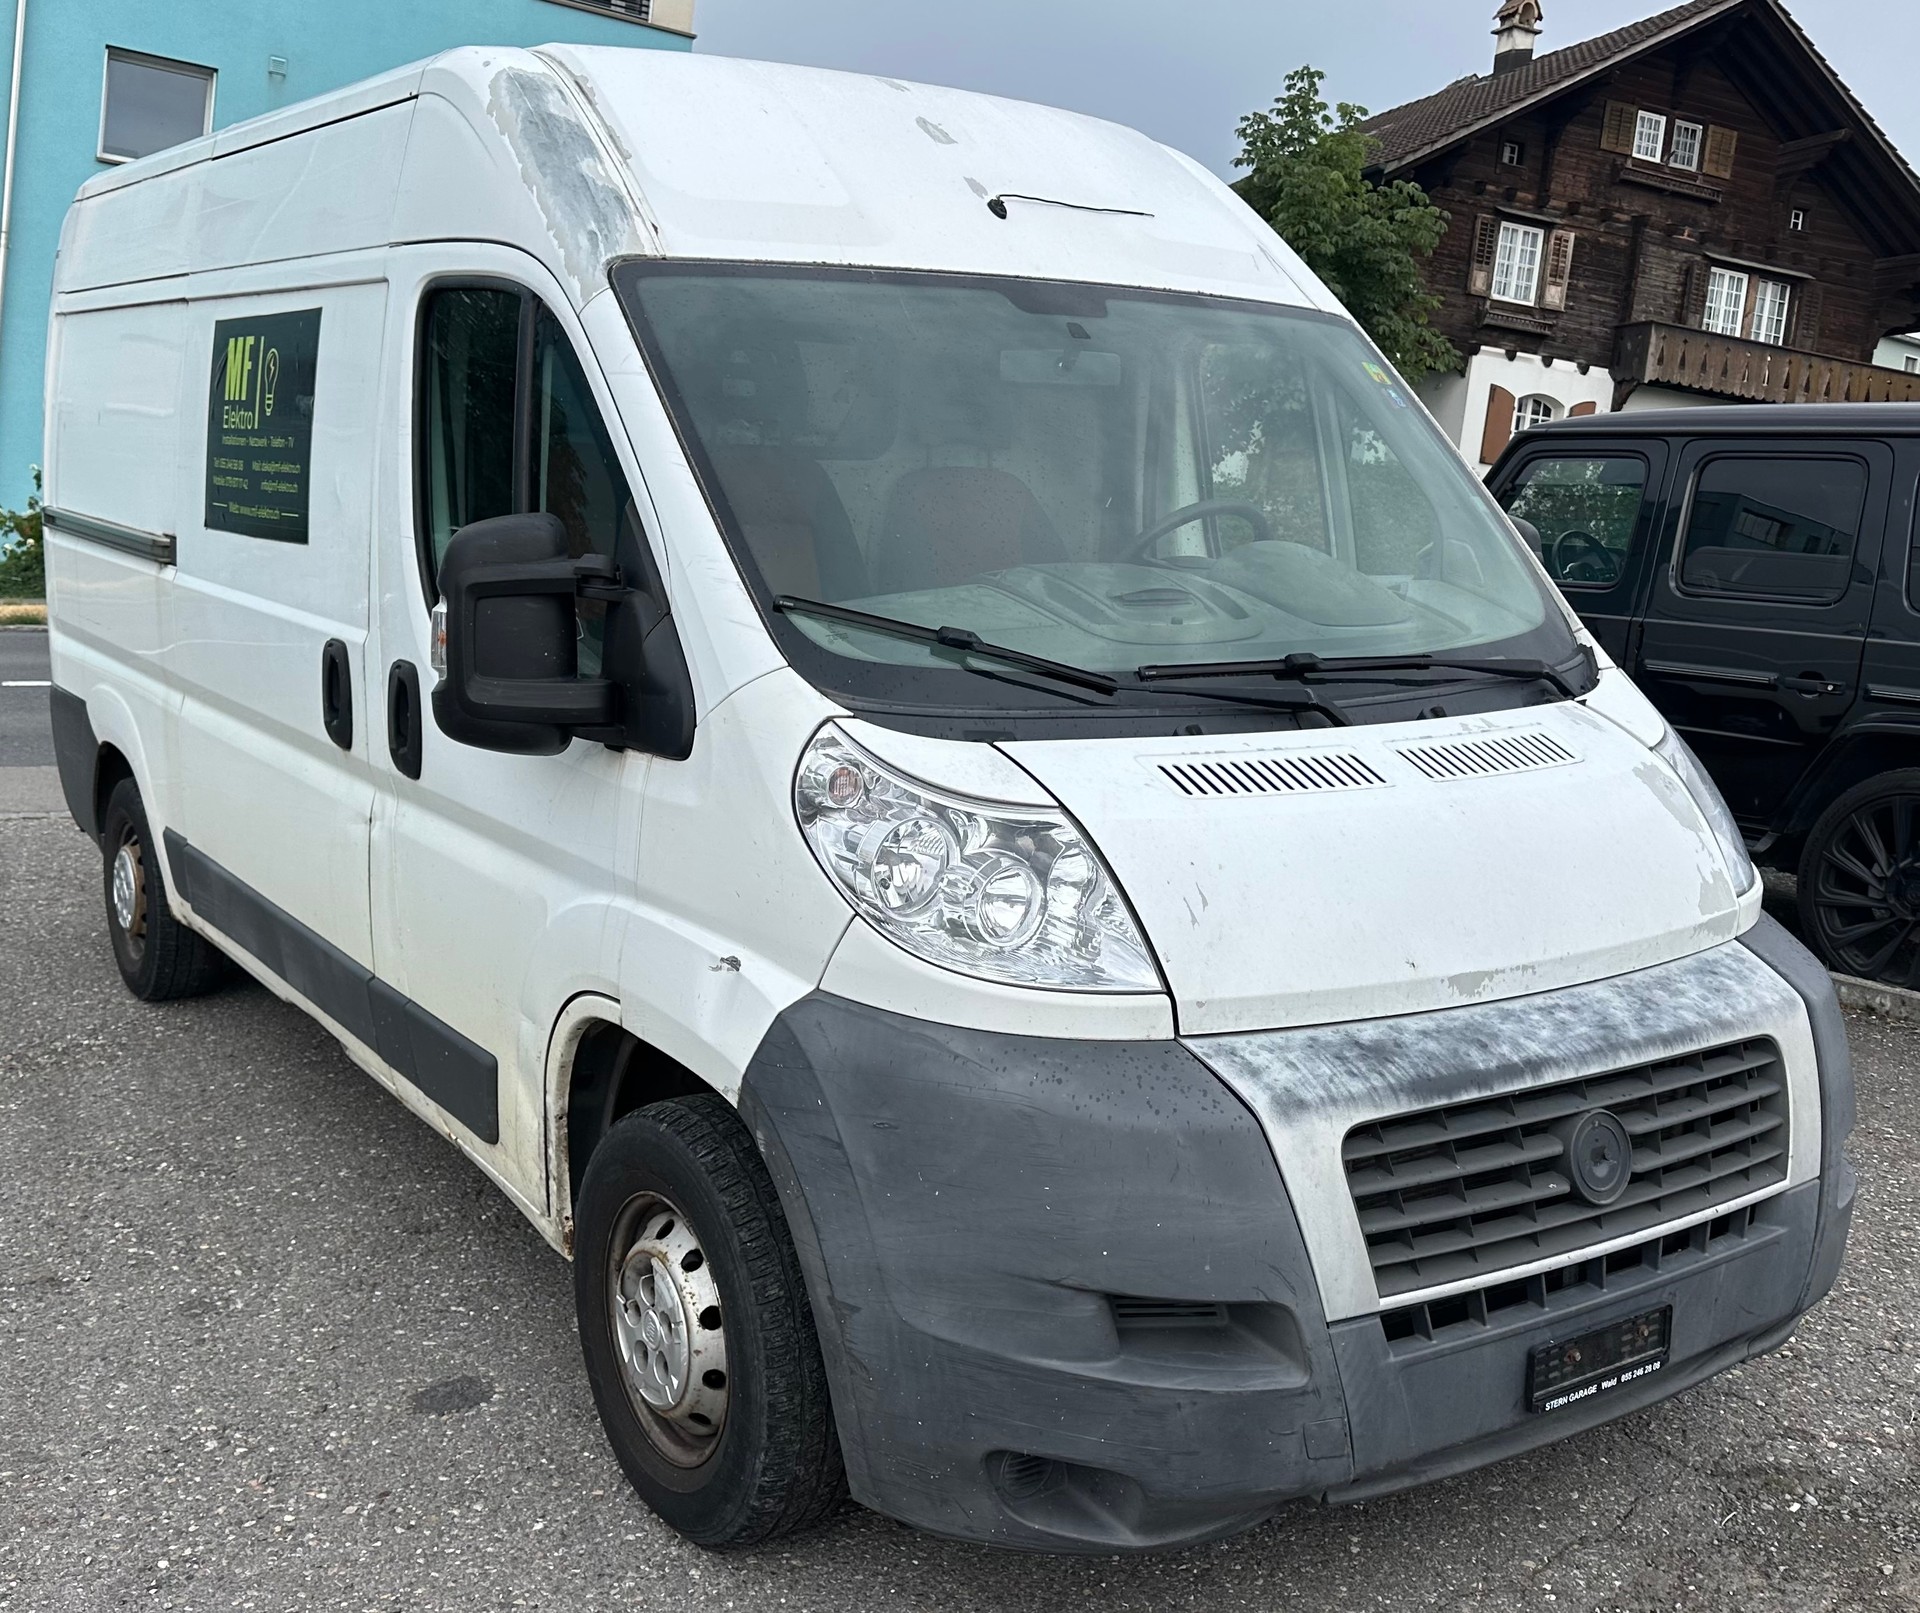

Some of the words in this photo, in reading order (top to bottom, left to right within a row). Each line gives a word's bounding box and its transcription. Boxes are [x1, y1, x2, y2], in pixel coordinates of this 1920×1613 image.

[224, 336, 255, 401] MF
[223, 406, 254, 430] Elektro
[288, 436, 295, 448] TV
[1545, 1395, 1568, 1411] STERN
[1568, 1384, 1598, 1402] GARAGE
[1601, 1377, 1618, 1390] Wald
[1621, 1371, 1632, 1382] 055
[1632, 1367, 1644, 1379] 246
